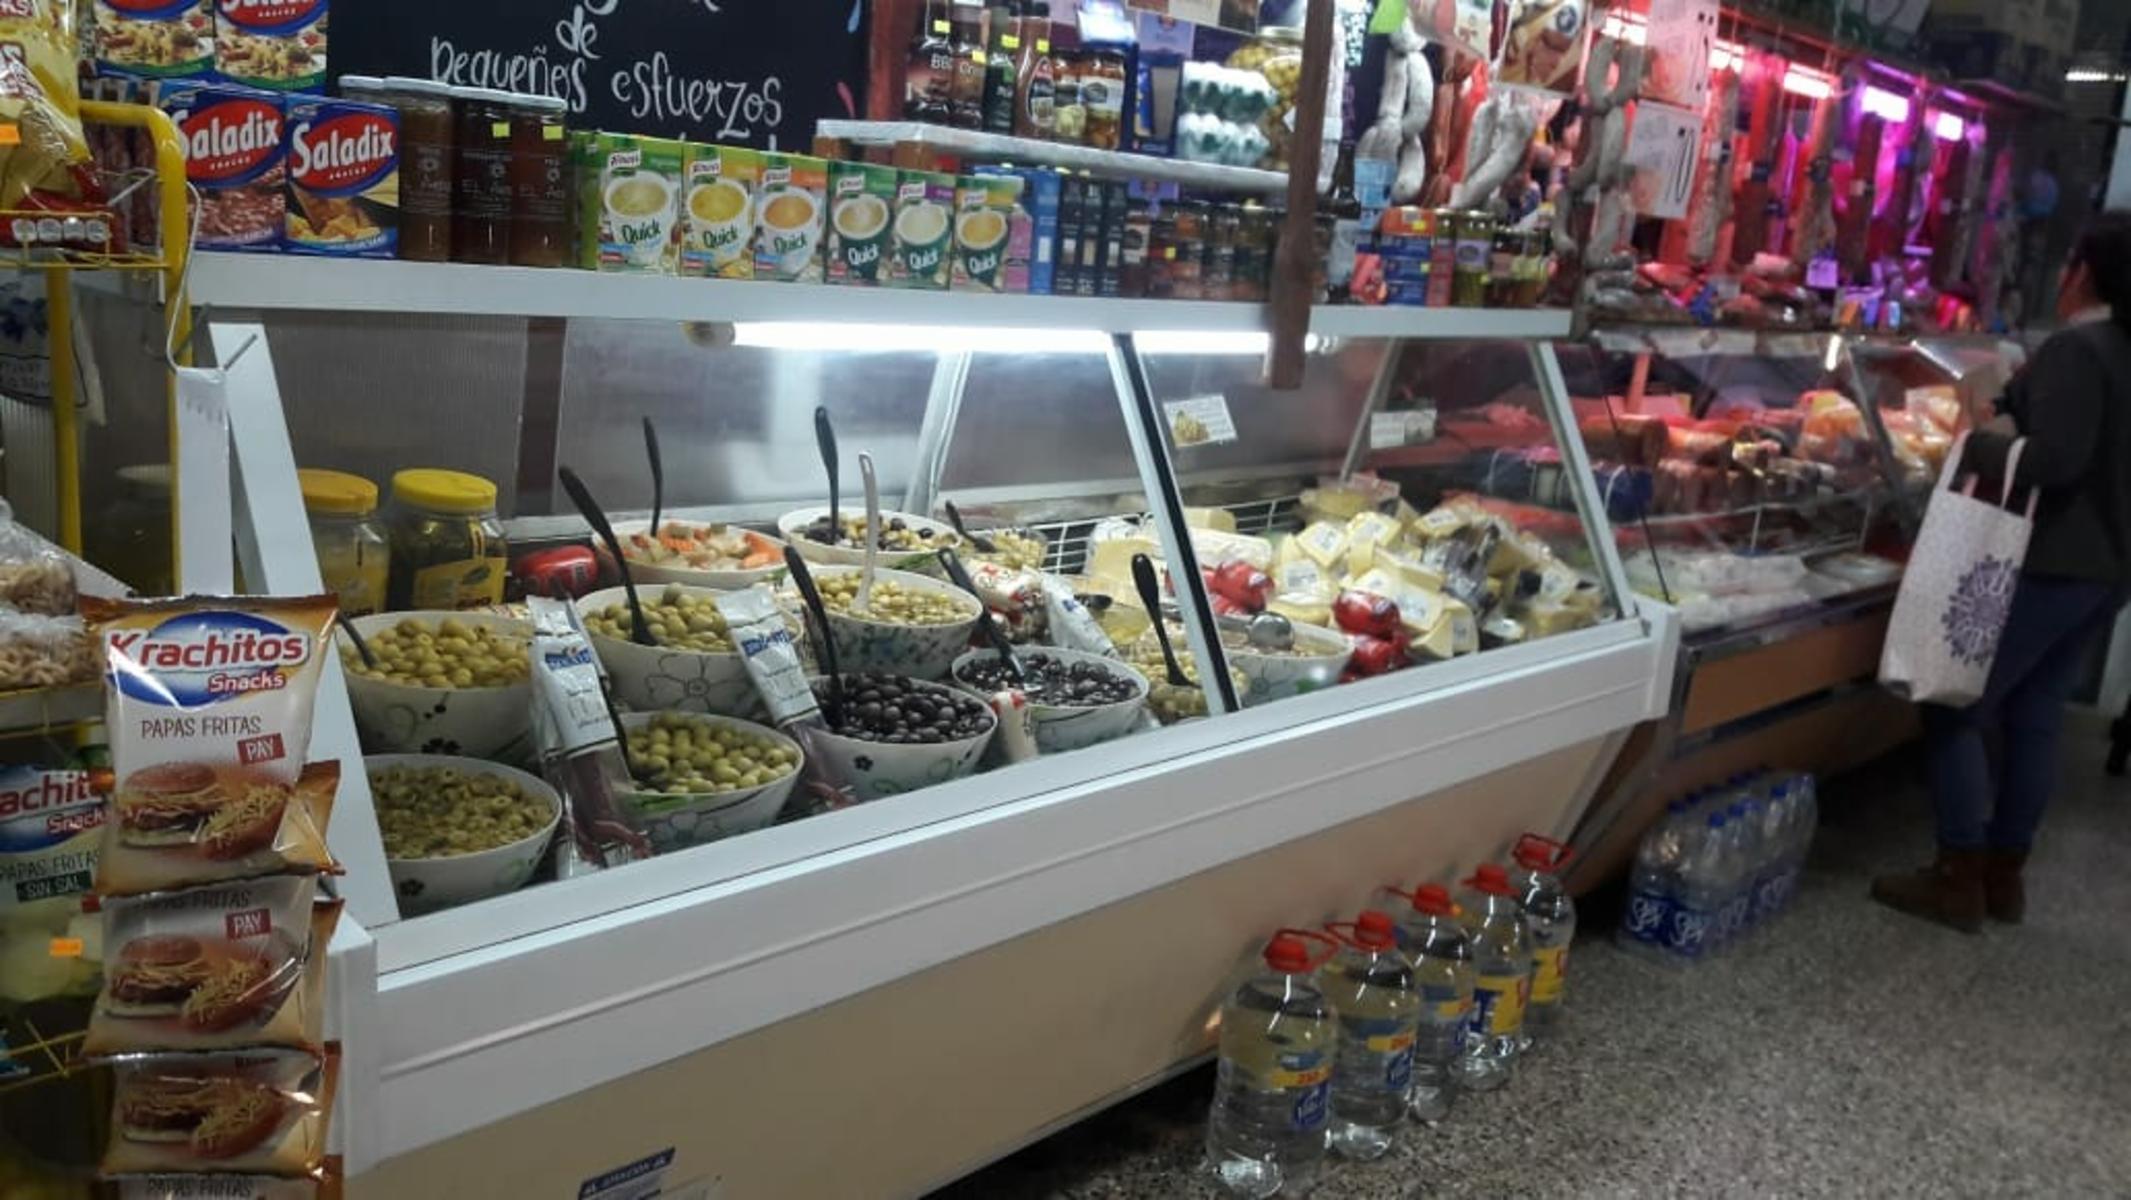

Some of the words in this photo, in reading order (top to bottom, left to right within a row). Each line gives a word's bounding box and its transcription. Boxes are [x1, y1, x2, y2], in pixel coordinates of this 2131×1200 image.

[556, 5, 602, 59] de
[611, 51, 783, 139] esfuerzos
[291, 121, 396, 178] Saladix
[620, 217, 662, 245] Quick
[702, 223, 739, 249] Quick
[106, 630, 304, 668] Krachitos
[209, 669, 284, 692] Snacks
[142, 717, 195, 739] PAPAS
[202, 714, 261, 736] FRITAS
[245, 737, 277, 761] PAY
[0, 773, 88, 816] achit
[47, 808, 109, 833] Snack
[234, 911, 263, 938] PAY
